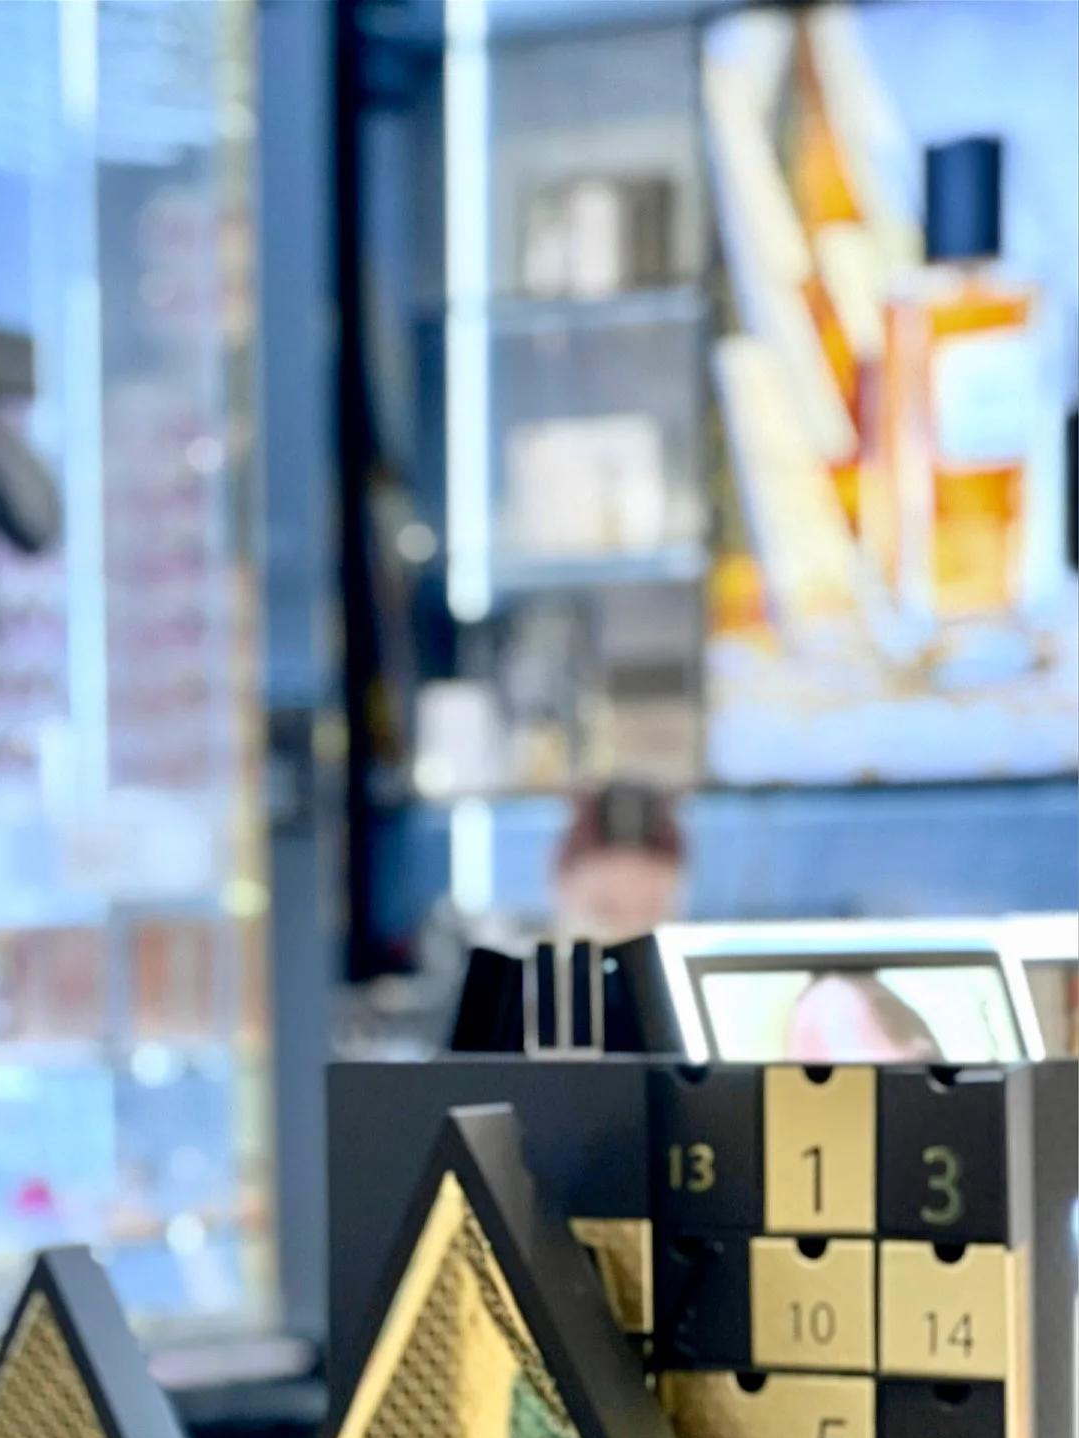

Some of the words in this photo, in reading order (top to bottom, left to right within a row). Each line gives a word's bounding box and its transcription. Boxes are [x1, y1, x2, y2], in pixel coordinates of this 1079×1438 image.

[668, 1143, 714, 1191] 13
[802, 1145, 822, 1214] 1
[921, 1145, 963, 1225] 3
[789, 1302, 836, 1346] 10
[924, 1311, 975, 1358] 14
